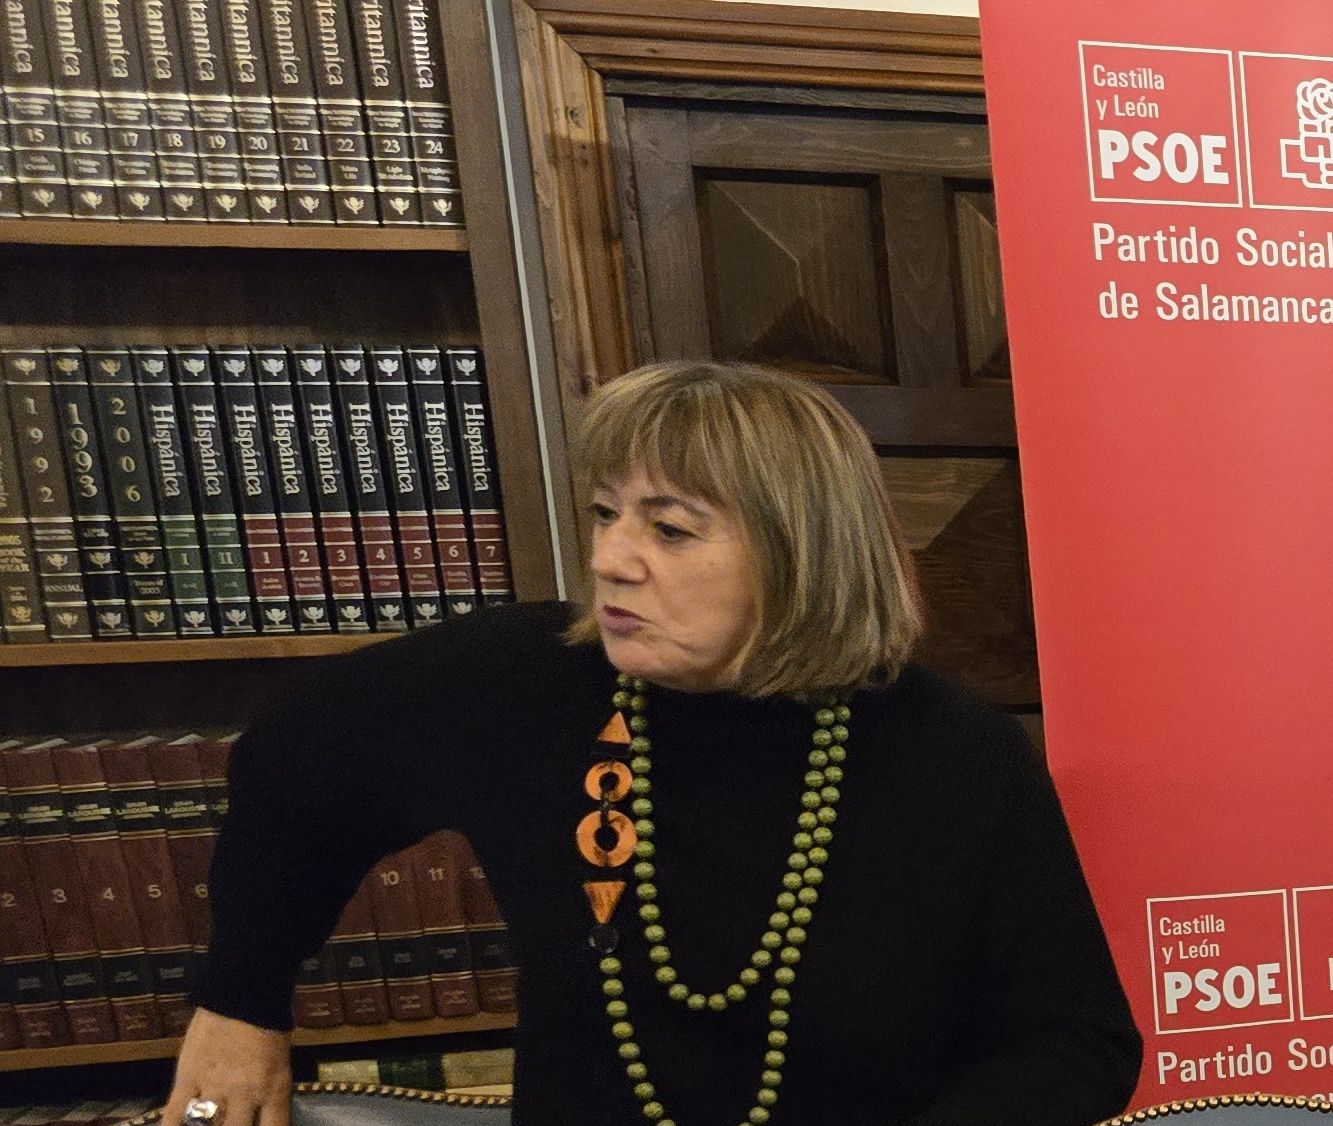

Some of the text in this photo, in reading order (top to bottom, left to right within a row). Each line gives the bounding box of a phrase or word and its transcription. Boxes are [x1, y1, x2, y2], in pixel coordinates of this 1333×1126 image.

[102, 0, 131, 79] tannica
[407, 0, 436, 90] ritannica
[1092, 64, 1165, 90] Castilla
[1096, 95, 1160, 120] y León
[27, 128, 45, 143] 15
[73, 131, 93, 146] 16
[121, 132, 139, 147] 17
[166, 133, 184, 148] 18
[209, 134, 227, 149] 19
[249, 136, 268, 151] 20
[291, 137, 309, 151] 21
[336, 138, 355, 153] 22
[382, 139, 401, 154] 23
[425, 140, 444, 155] 24
[1098, 129, 1230, 184] PSOE
[1092, 223, 1219, 265] Partido
[1099, 281, 1139, 319] de
[151, 404, 181, 498] Hispánica
[192, 404, 223, 497] Hispánica
[233, 404, 266, 497] Hispánica
[271, 403, 303, 495] Hispánica
[309, 402, 342, 495] Hispánica
[348, 402, 379, 494] Hispánica
[385, 402, 415, 494] Hispánica
[423, 401, 455, 492] Hispánica
[463, 402, 493, 493] Hispánica
[299, 549, 310, 563] 2
[336, 549, 347, 561] 3
[375, 548, 386, 561] 4
[412, 547, 423, 560] 5
[448, 545, 459, 558] 6
[485, 545, 496, 558] 7
[379, 869, 400, 887] 10
[428, 866, 445, 882] 11
[52, 887, 68, 904] 3
[102, 887, 116, 902] 4
[148, 885, 163, 899] 5
[195, 883, 210, 899] 6
[1158, 914, 1226, 937] Castilla
[1161, 941, 1220, 965] y León
[1163, 962, 1283, 1015] PSOE
[1157, 1043, 1273, 1085] Partido
